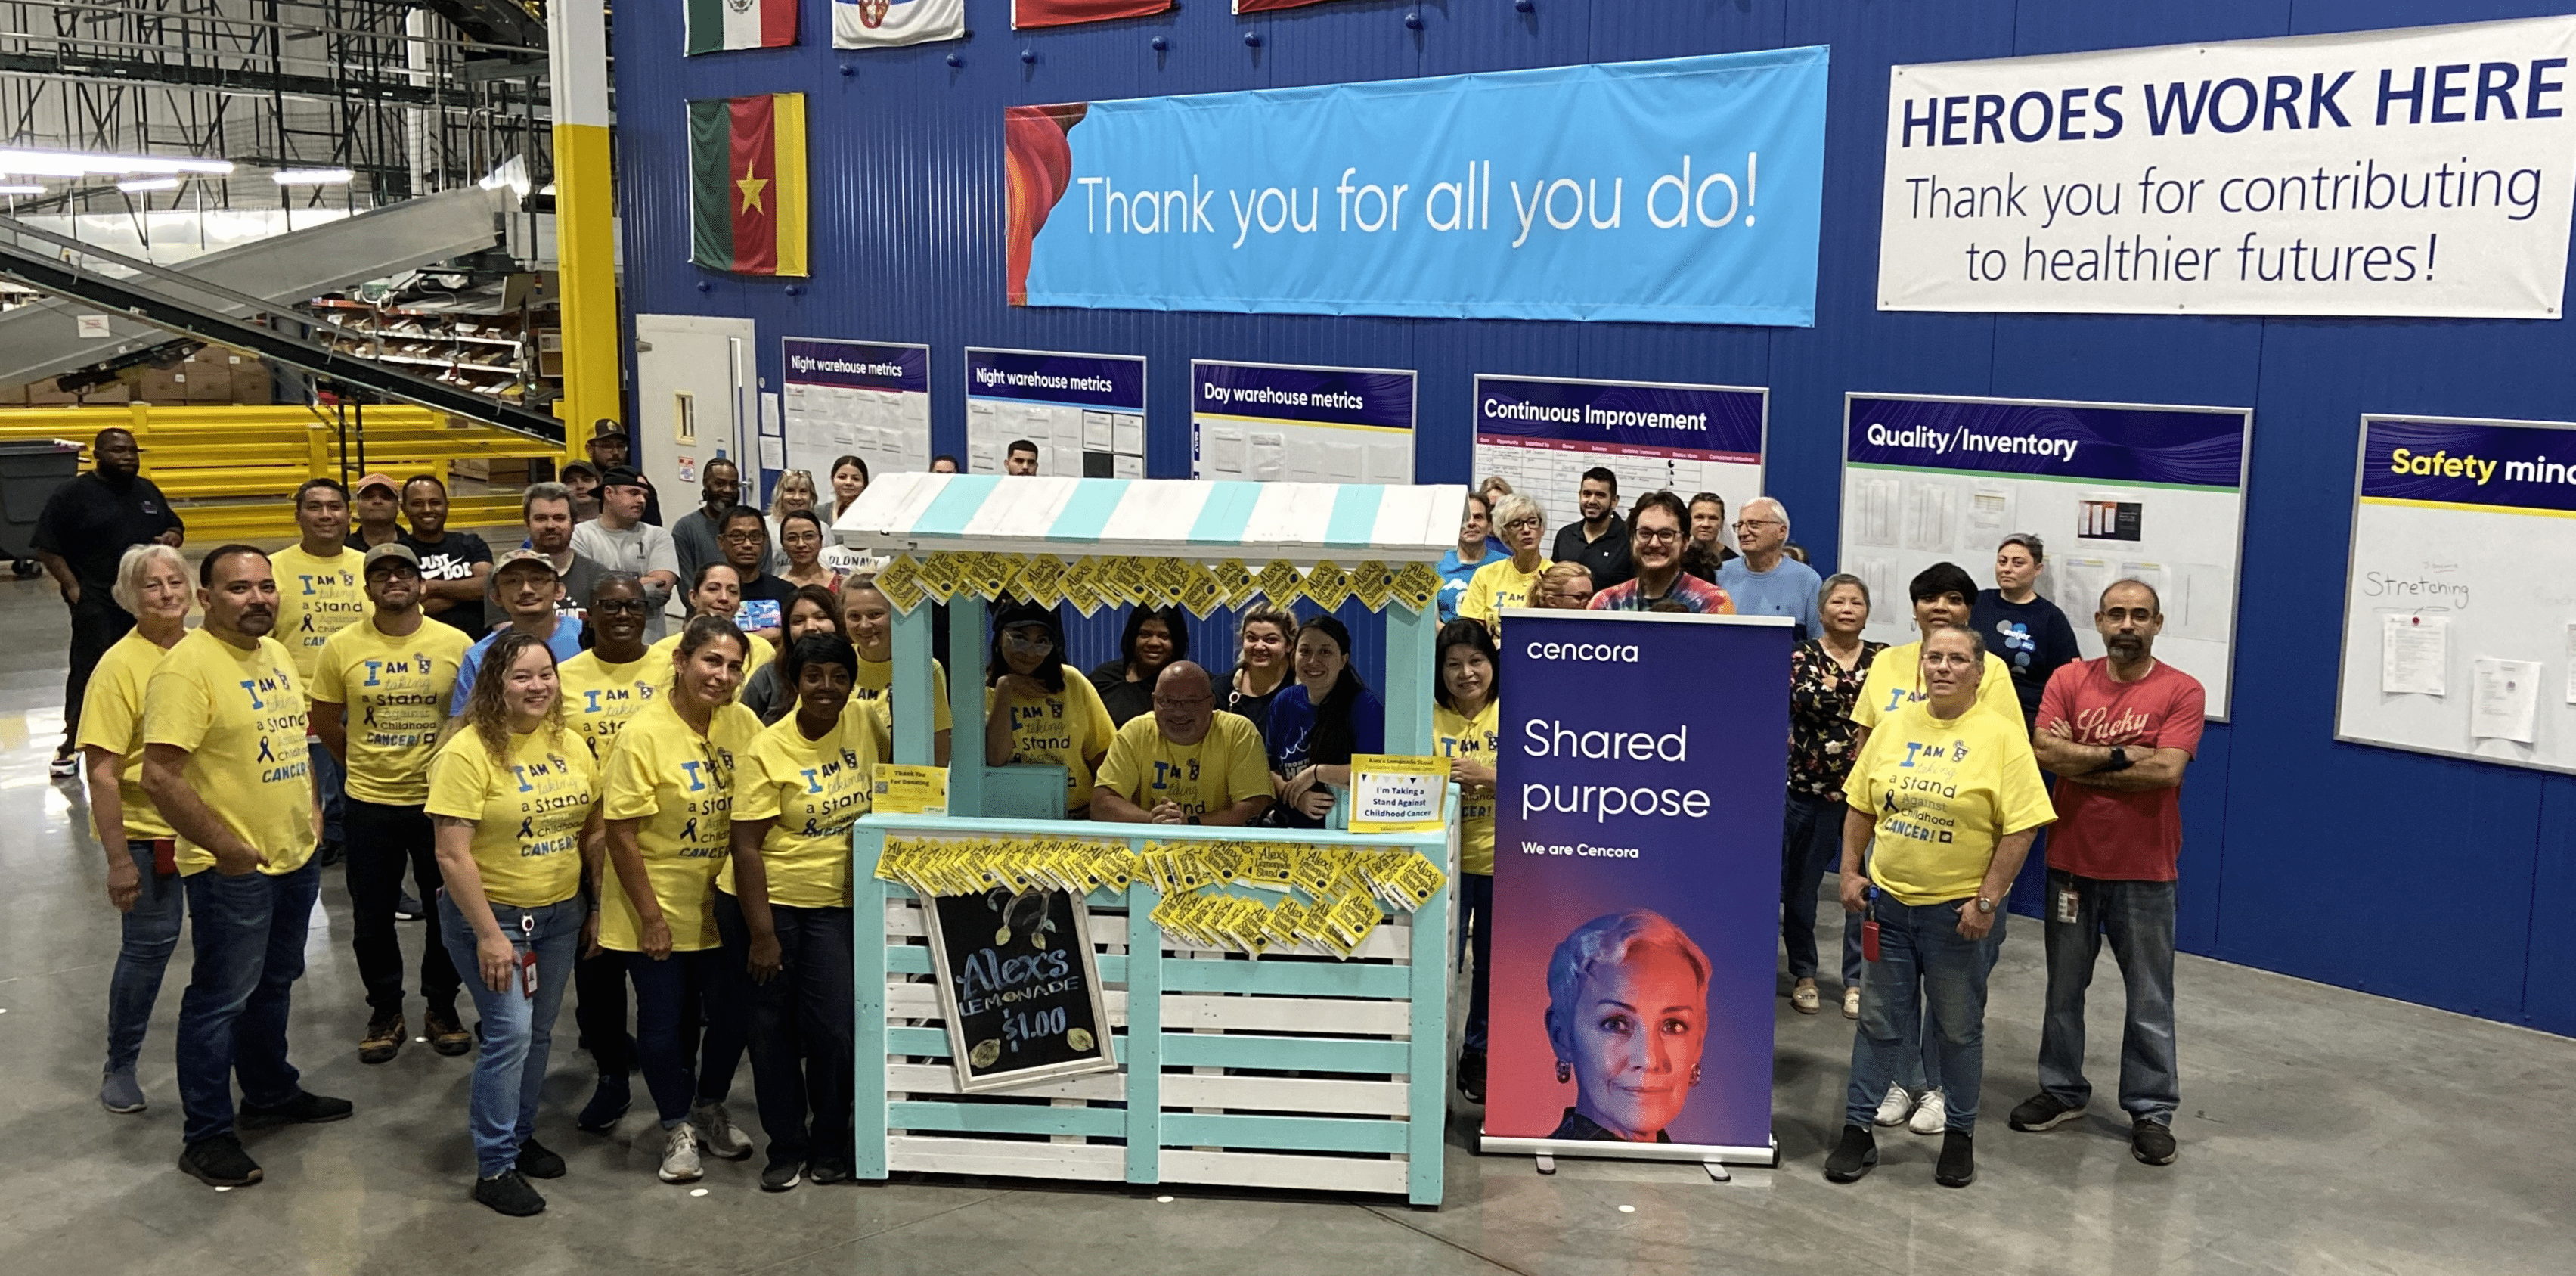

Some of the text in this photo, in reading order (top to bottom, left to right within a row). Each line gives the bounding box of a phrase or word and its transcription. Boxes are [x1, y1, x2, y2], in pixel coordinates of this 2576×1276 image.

[1901, 57, 2569, 149] HEROES WORK HERE
[1077, 151, 1758, 249] Thank you for all you do!
[1905, 156, 2543, 229] Thank you for contributing
[1966, 231, 2438, 283] to healthier futures!
[791, 355, 903, 377] Night warehouse metrics
[975, 367, 1112, 393] Night warehouse metrics
[1204, 382, 1364, 409] Day warehouse metrics
[1483, 399, 1707, 430] Continuous Improvement
[1866, 422, 2078, 462] Quality/Inventory
[2390, 448, 2497, 486] Safety
[418, 553, 449, 570] JUST
[829, 555, 851, 566] OLD
[298, 575, 335, 595] I AM
[1066, 564, 1093, 591] Alex's
[1259, 561, 1284, 588] Alex's
[1307, 566, 1329, 594] Alex's
[1400, 570, 1434, 596] Lemonade
[1408, 564, 1437, 588] Alex's
[1396, 579, 1418, 596] Stand
[2364, 571, 2469, 610] Stretching
[315, 601, 363, 613] Stand
[1493, 591, 1525, 608] I AM
[2003, 629, 2032, 641] meijer
[1527, 641, 1639, 663] cencora
[364, 661, 408, 687] I AM
[240, 678, 277, 710] I AM
[376, 692, 437, 706] Stand
[584, 689, 629, 713] I AM
[857, 688, 879, 700] AM
[1884, 688, 1906, 712] I
[1022, 706, 1043, 719] AM
[256, 720, 264, 731] a
[380, 722, 436, 730] Childhood
[583, 722, 592, 731] a
[2076, 706, 2150, 744] Lucky
[1022, 735, 1070, 751] Stand
[1459, 740, 1480, 752] AM
[1523, 718, 1687, 762] Shared
[1899, 742, 1945, 768] I AM
[529, 764, 550, 777] AM
[680, 760, 705, 792] I
[799, 761, 841, 793] I AM
[1152, 761, 1169, 790] I
[1915, 761, 1958, 782] taking
[902, 779, 929, 787] Donating
[1391, 787, 1418, 796] Taking
[1889, 775, 1958, 799] a Stand
[522, 790, 590, 813] a Stand
[688, 803, 697, 812] a
[806, 804, 815, 814] a
[1372, 798, 1426, 808] Stand Against
[1521, 782, 1710, 823] purpose
[1902, 793, 1948, 813] Against
[1364, 809, 1406, 818] Childhood
[1884, 818, 1936, 843] CANCER!
[1259, 846, 1288, 862] Alex's
[1308, 850, 1334, 872] Alex's
[1521, 841, 1640, 858] We are Cencora
[1256, 867, 1278, 877] Stand
[1412, 860, 1439, 883] Alex's
[1347, 895, 1375, 922] Alex's
[956, 948, 1069, 1000] Alex's
[958, 976, 1080, 1017] LEMONADE
[1002, 1006, 1067, 1053] $1.00
